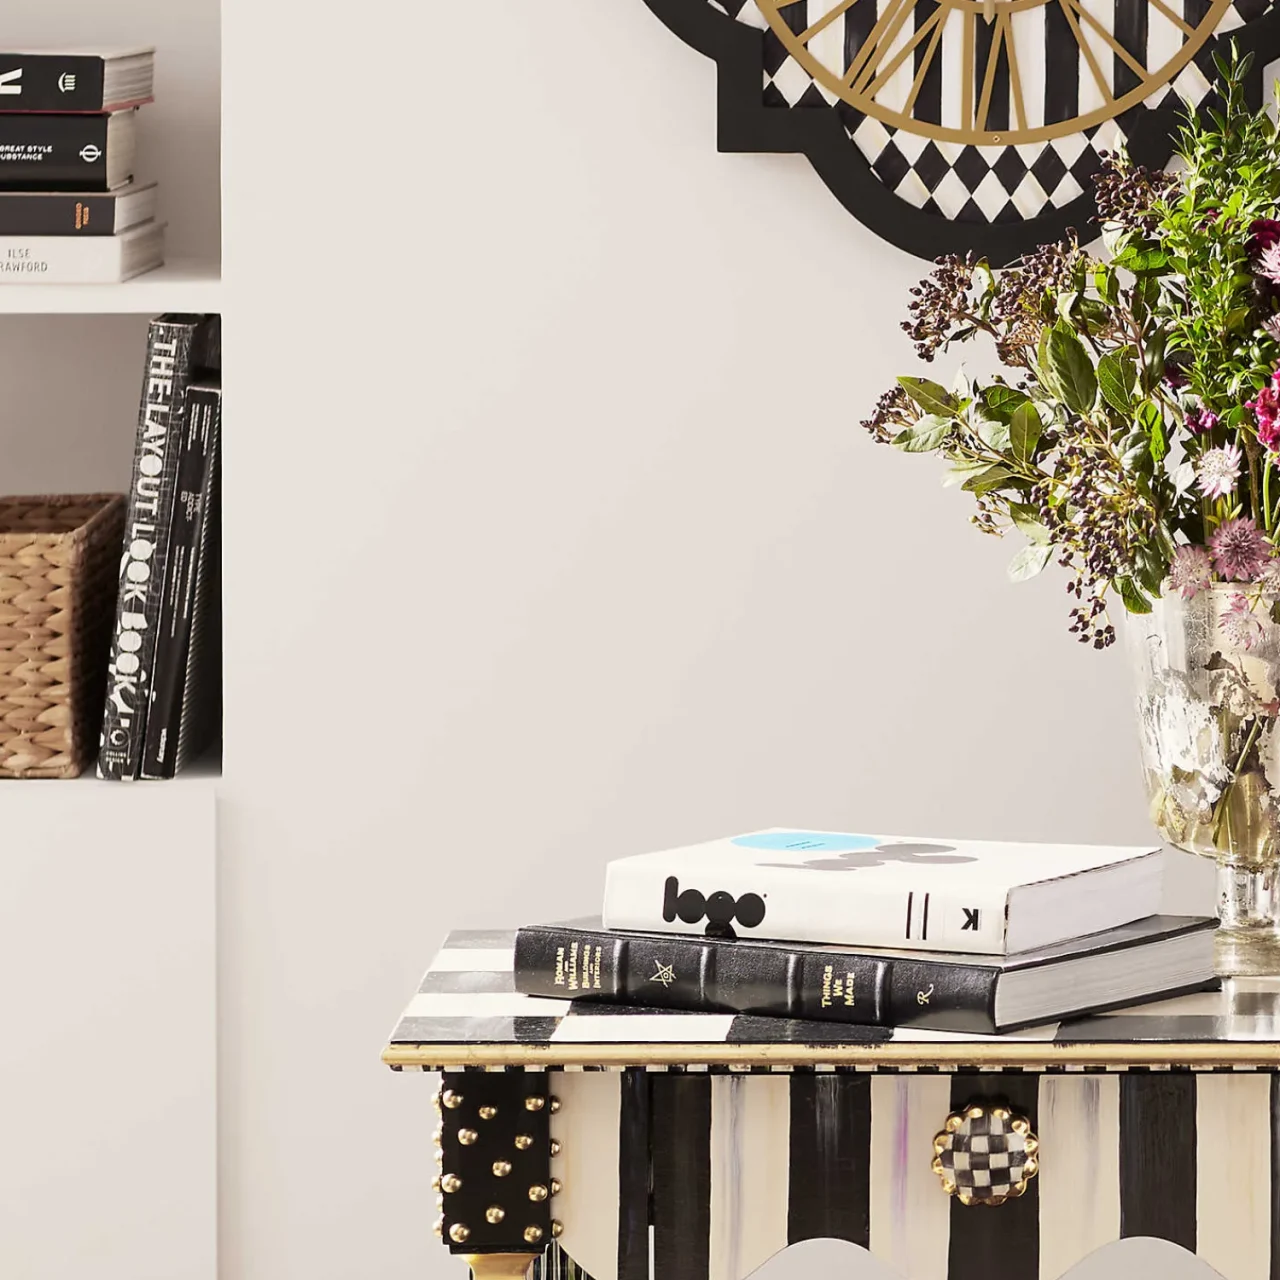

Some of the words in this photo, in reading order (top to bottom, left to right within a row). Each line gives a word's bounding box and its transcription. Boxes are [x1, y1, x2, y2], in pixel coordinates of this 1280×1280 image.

[0, 153, 43, 161] UBSTANCE
[0, 261, 48, 272] RAWFORD
[8, 248, 30, 258] ILSE
[149, 338, 177, 397] THE
[135, 403, 170, 516] LAYOUT
[124, 522, 156, 602] LOOK
[554, 947, 565, 985] ROMAN
[568, 942, 579, 990] WILLIAMS
[821, 965, 833, 1008] THINGS
[833, 979, 843, 996] WE
[844, 972, 855, 1006] MADE
